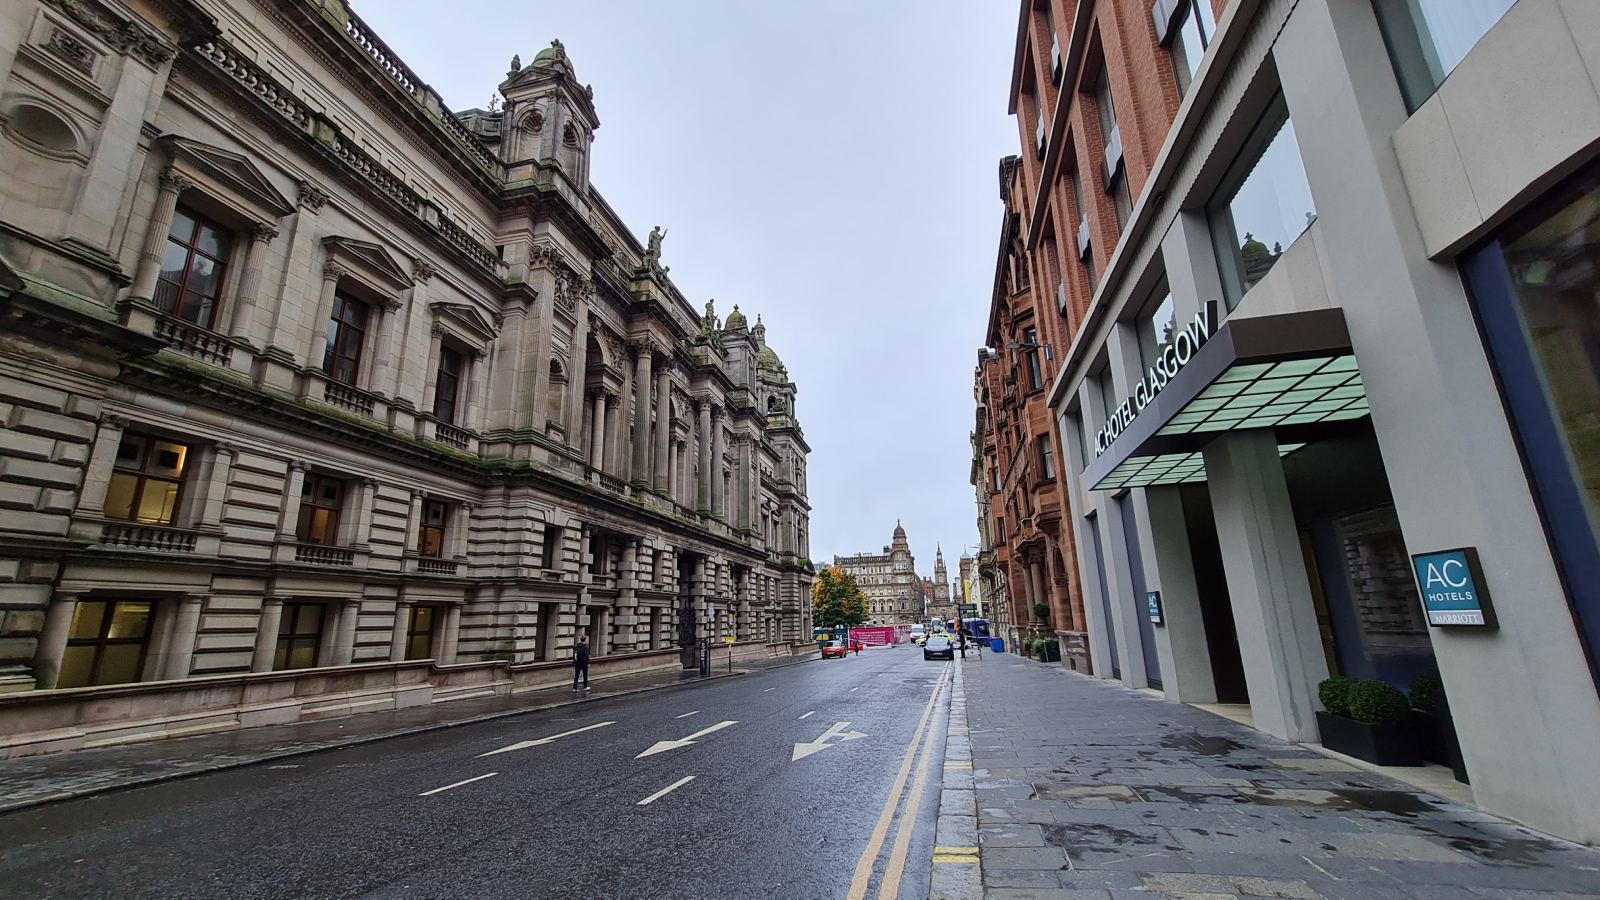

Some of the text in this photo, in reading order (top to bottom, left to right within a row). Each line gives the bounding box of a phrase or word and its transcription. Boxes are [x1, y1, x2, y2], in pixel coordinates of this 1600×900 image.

[1094, 300, 1214, 455] AC HOTEL GLASGOW
[1426, 559, 1467, 589] AC
[1428, 591, 1473, 602] HOTELS
[1434, 614, 1478, 624] MARRIOTT
